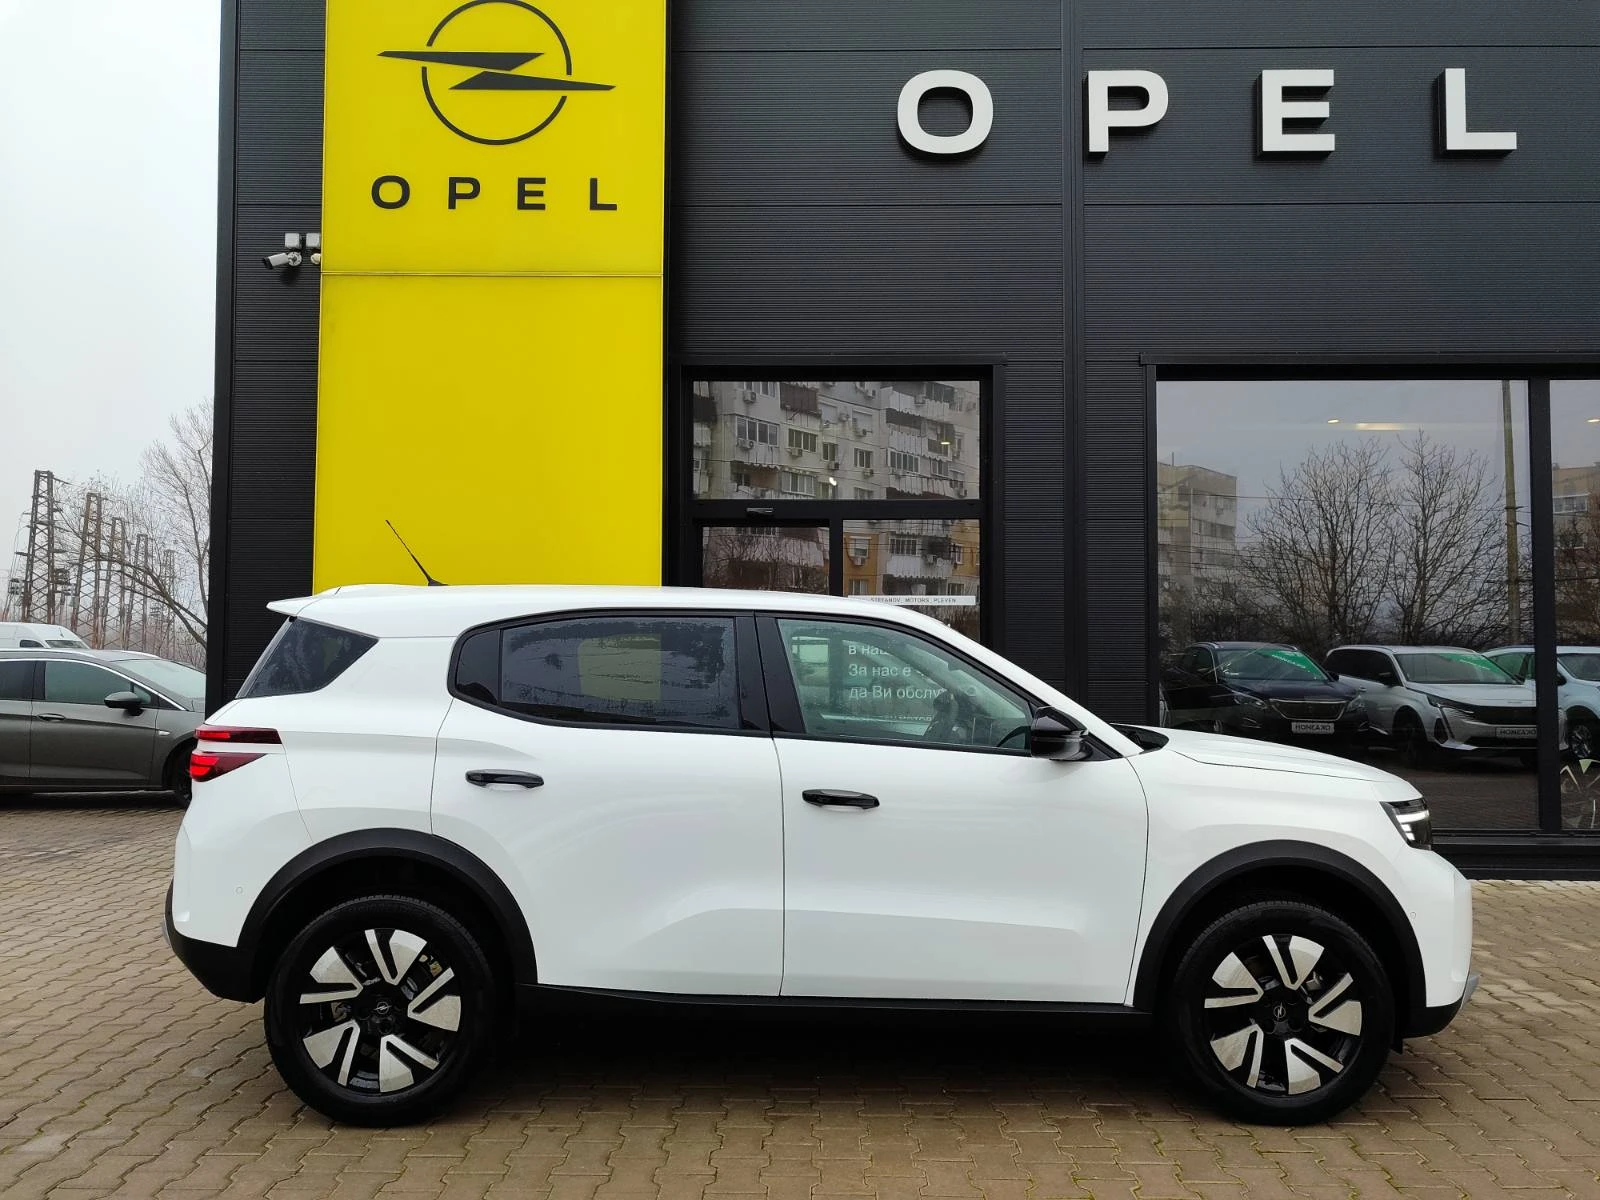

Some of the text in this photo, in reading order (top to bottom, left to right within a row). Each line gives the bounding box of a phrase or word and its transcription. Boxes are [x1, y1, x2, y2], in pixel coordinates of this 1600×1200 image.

[897, 67, 1518, 155] OPEL
[371, 175, 618, 211] OPEL
[848, 663, 868, 677] За
[872, 666, 899, 677] нас
[849, 685, 945, 700] да Ви обслу
